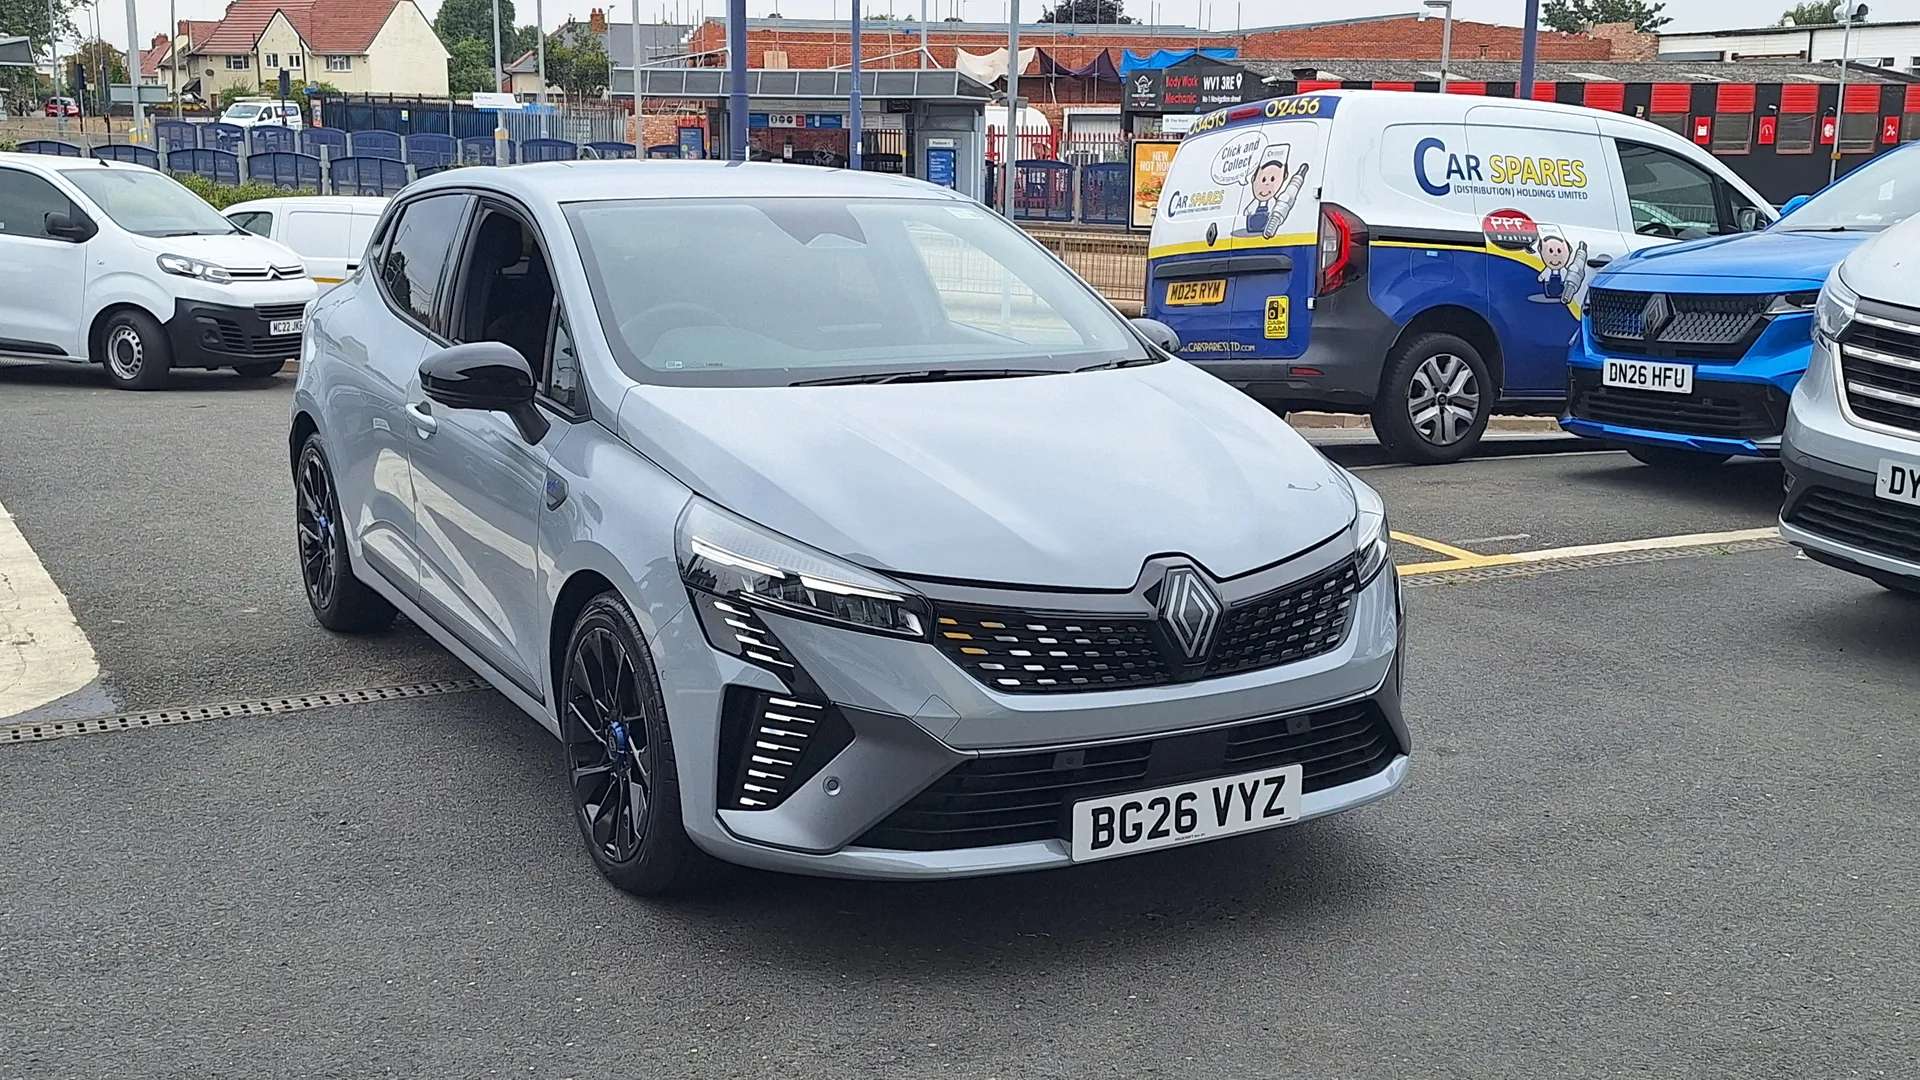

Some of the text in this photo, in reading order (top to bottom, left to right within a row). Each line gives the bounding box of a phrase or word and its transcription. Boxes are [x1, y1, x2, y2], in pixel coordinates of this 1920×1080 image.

[1203, 76, 1235, 90] WV1 3RE
[1165, 92, 1197, 104] Mechanic
[1265, 97, 1320, 118] 02456
[1221, 139, 1260, 160] Click and
[1222, 155, 1252, 173] Collect
[1489, 154, 1588, 188] SPARES
[1454, 185, 1588, 200] (DISTRIBUTION) HOLDINGS LIMITED
[1490, 216, 1525, 231] PPF
[1497, 234, 1533, 243] Braking
[1170, 281, 1221, 301] MD25 RYM
[273, 322, 290, 332] MC22
[1609, 362, 1686, 388] DN26 HFU
[1889, 466, 1920, 499] DY
[1090, 774, 1286, 851] BG26 VYZ
